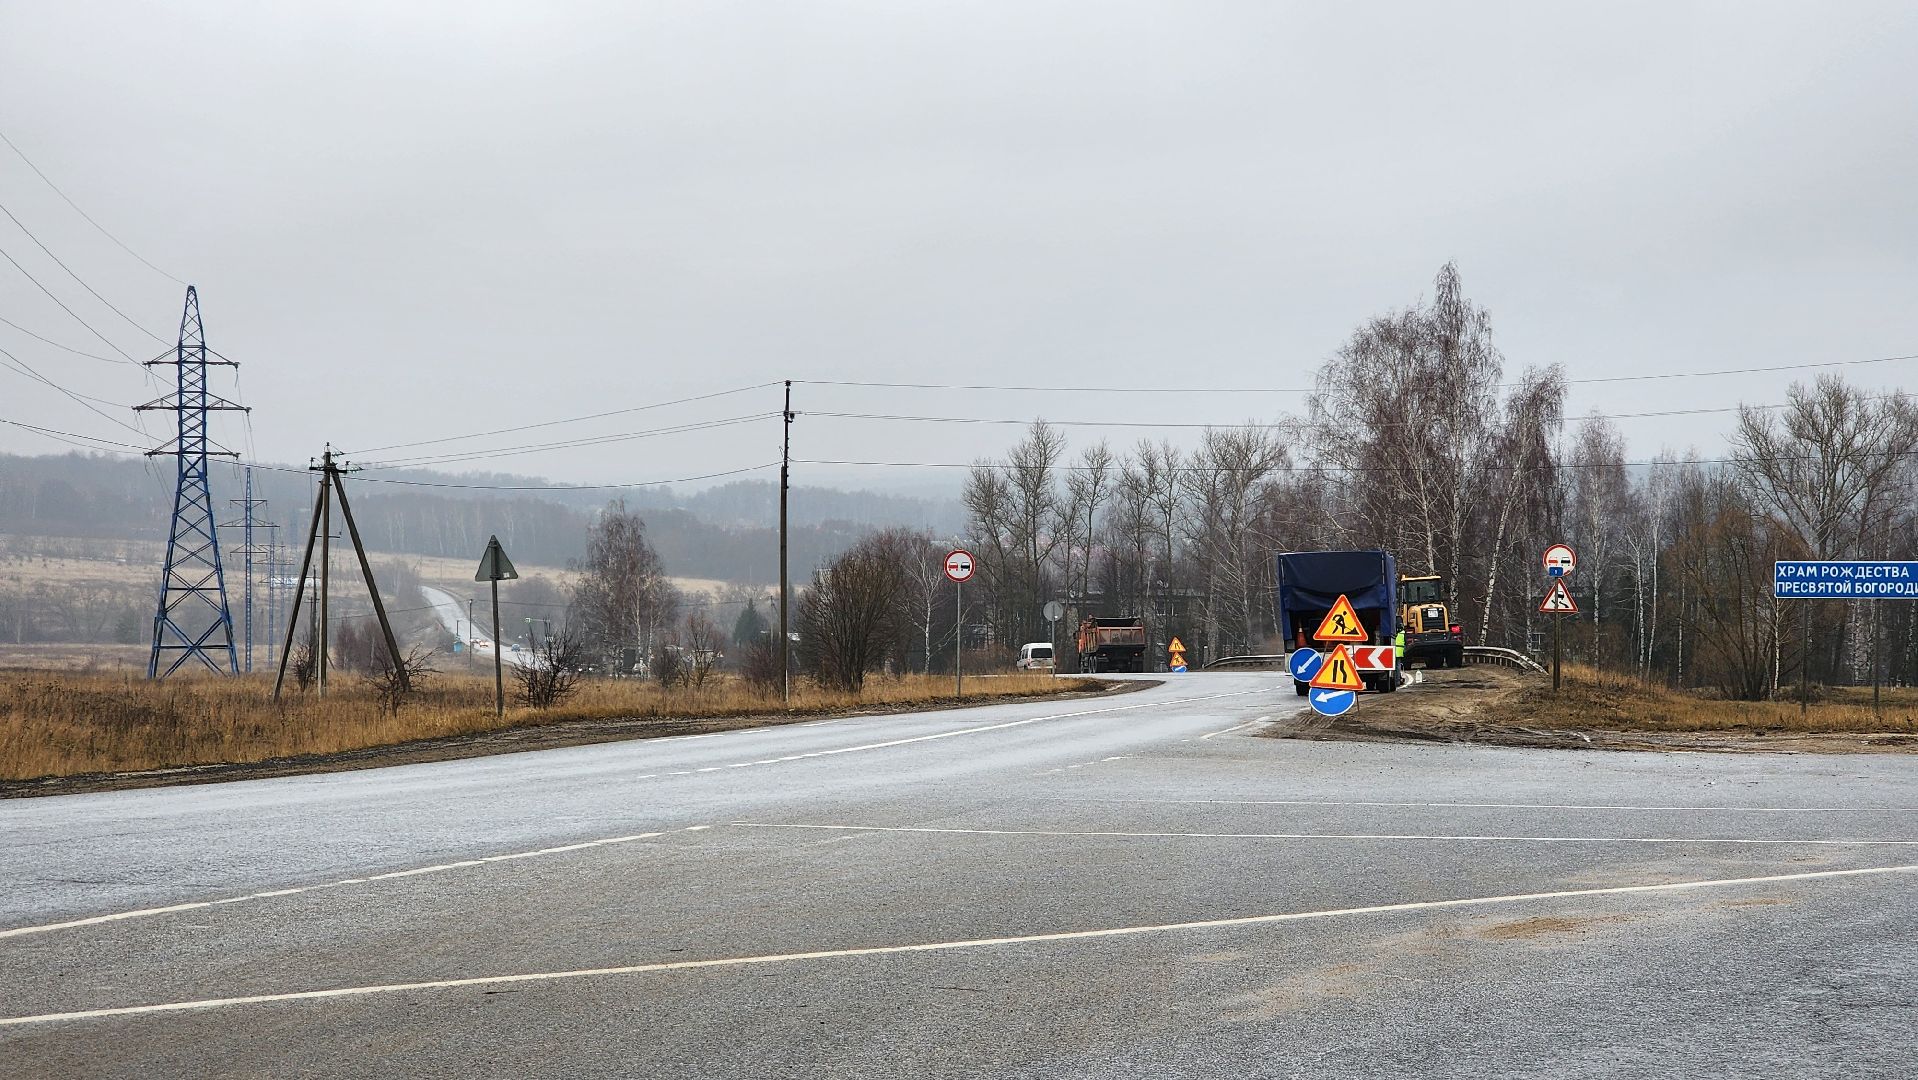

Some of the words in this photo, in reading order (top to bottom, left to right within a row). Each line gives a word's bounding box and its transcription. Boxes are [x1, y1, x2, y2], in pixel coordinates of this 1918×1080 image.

[1778, 566, 1817, 577] ХРАМ
[1821, 566, 1909, 579] РОЖДЕСТВА
[1776, 580, 1852, 593] ПРЕСВЯТОЙ
